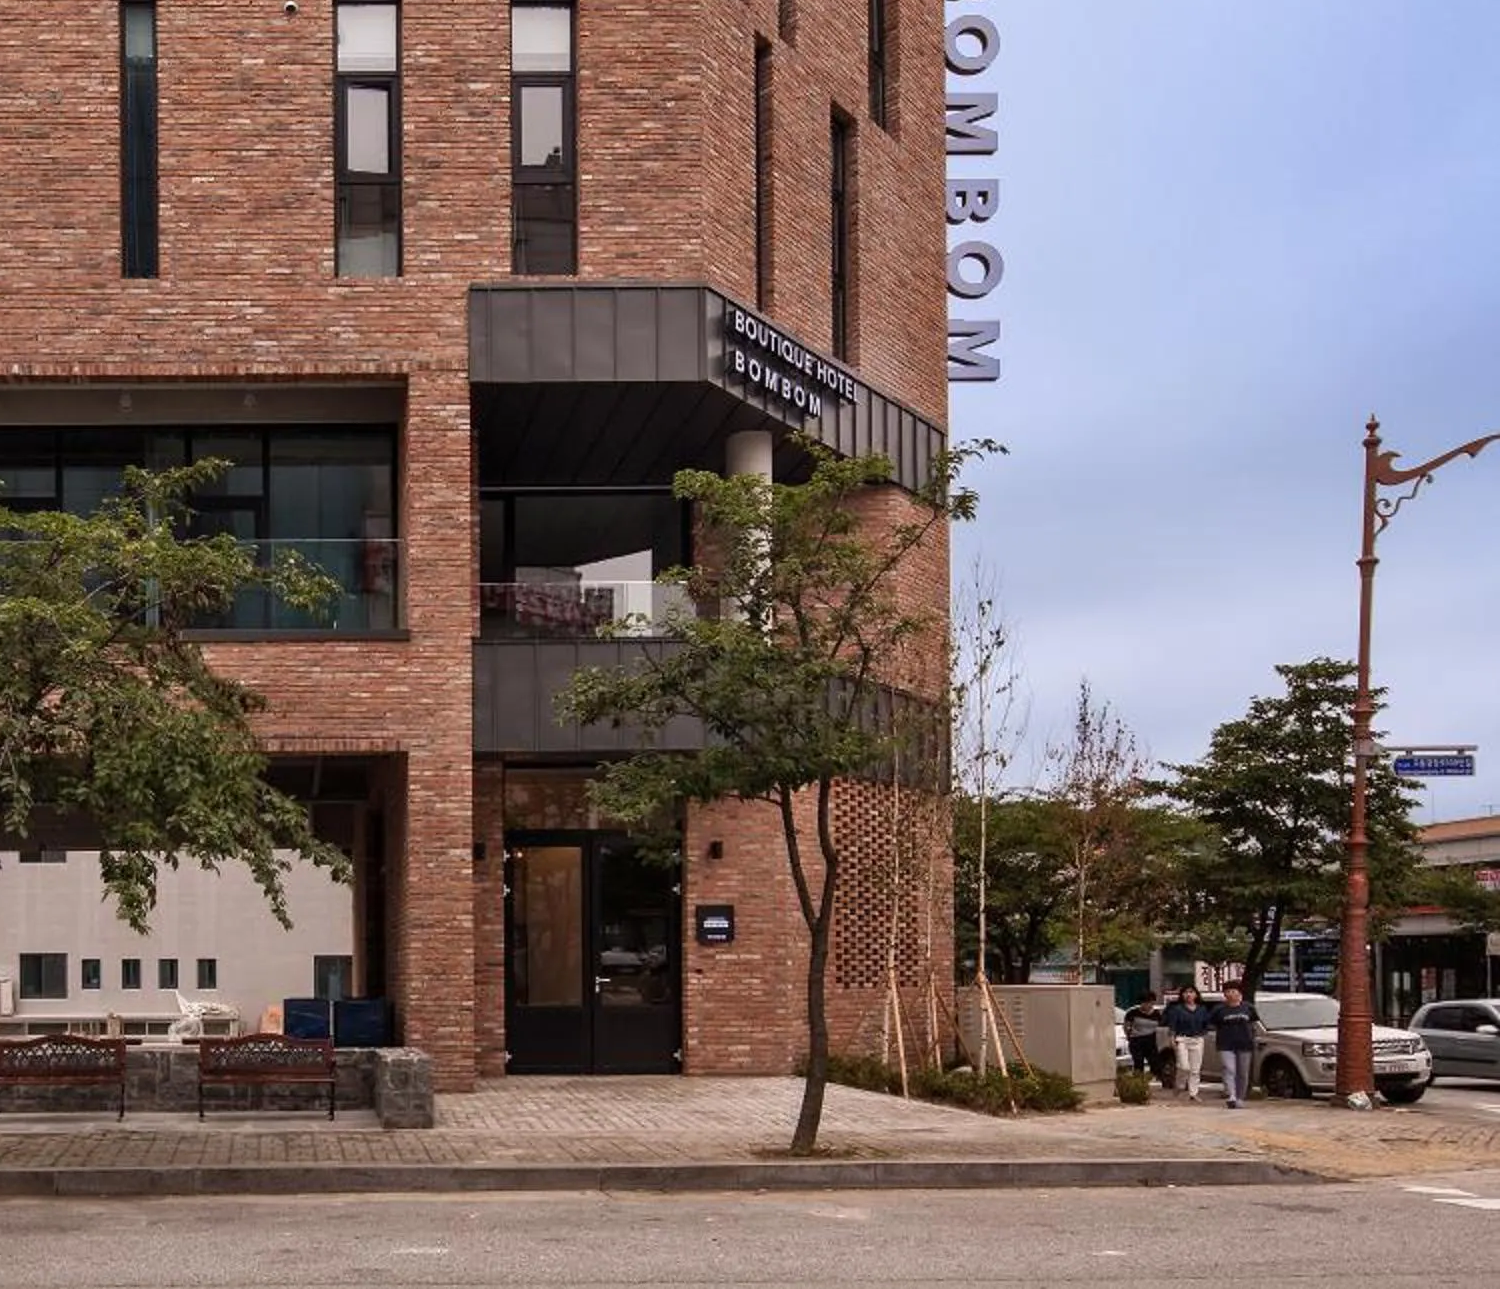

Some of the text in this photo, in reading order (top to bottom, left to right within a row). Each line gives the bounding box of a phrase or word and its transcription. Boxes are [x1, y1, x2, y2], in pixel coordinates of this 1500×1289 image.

[735, 310, 859, 403] BOUTIQUE HOTEL
[735, 350, 821, 417] BOMBOM
